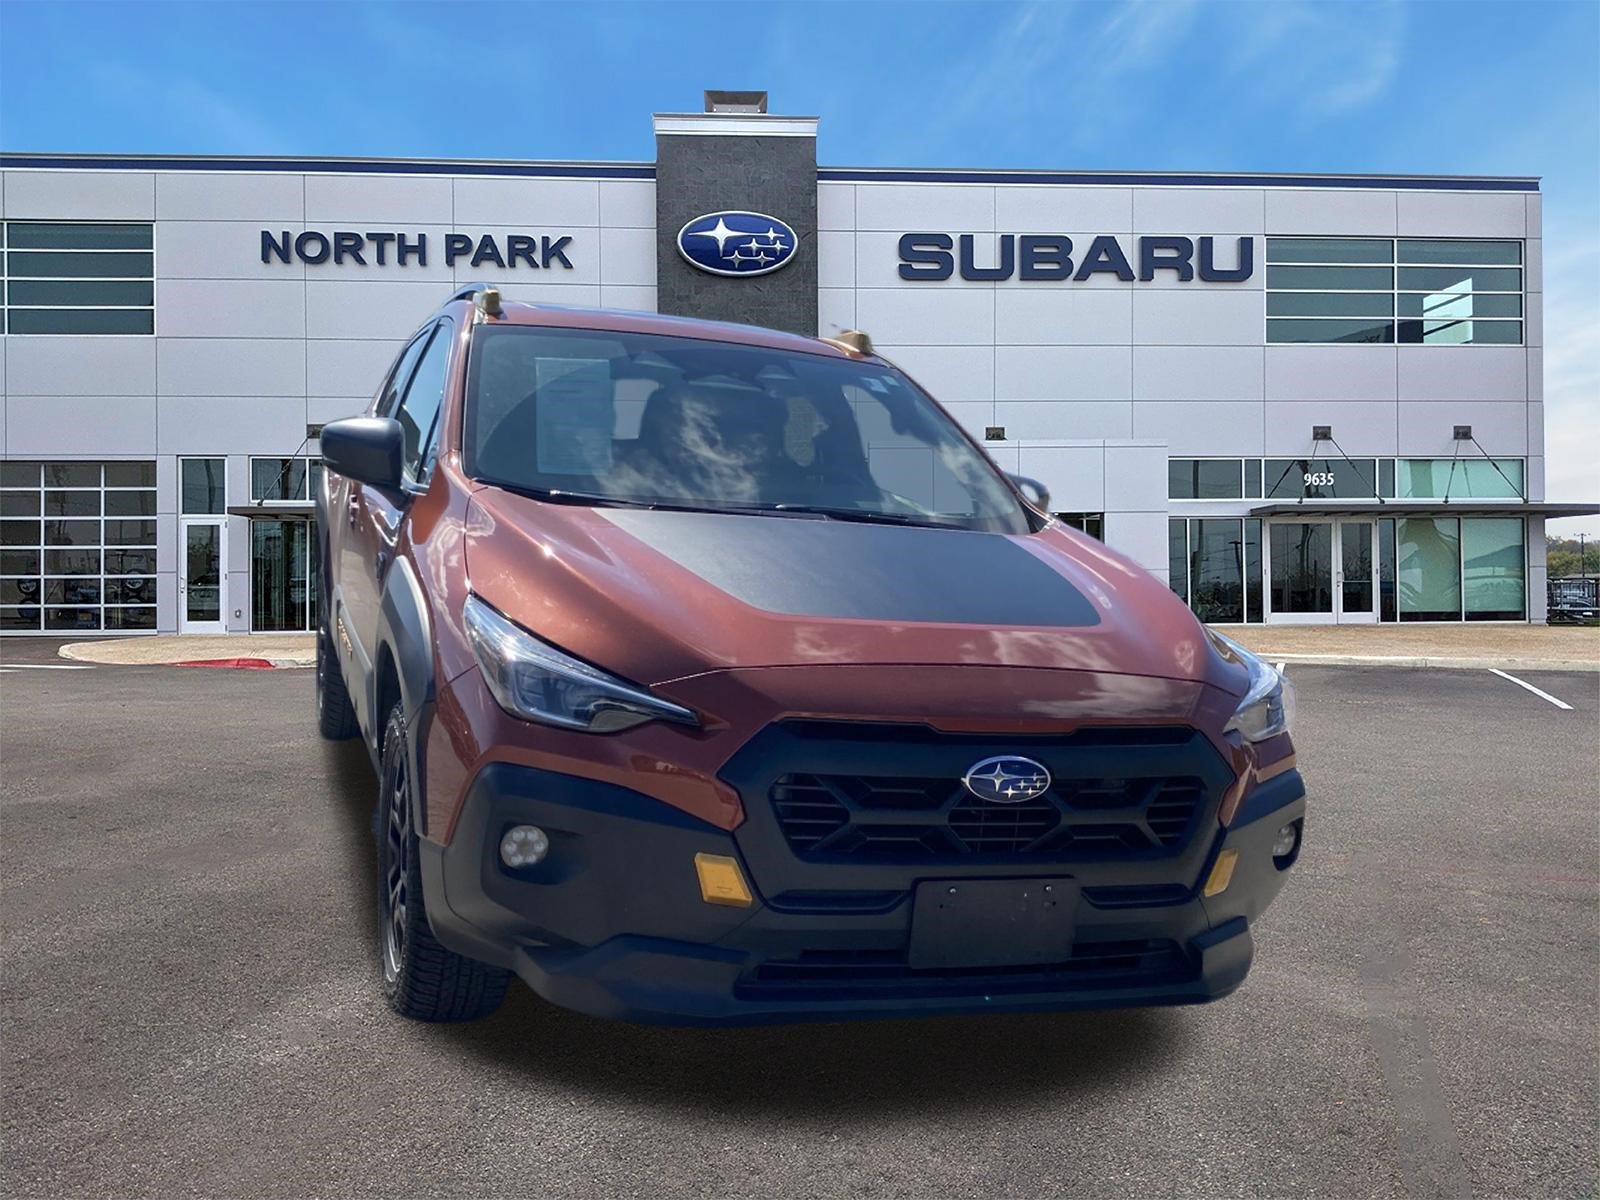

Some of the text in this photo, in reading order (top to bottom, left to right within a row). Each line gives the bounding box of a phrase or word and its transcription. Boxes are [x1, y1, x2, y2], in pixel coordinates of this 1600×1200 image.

[260, 230, 574, 270] NORTH PARK
[898, 233, 1254, 283] SUBARU
[1303, 472, 1335, 486] 9635
